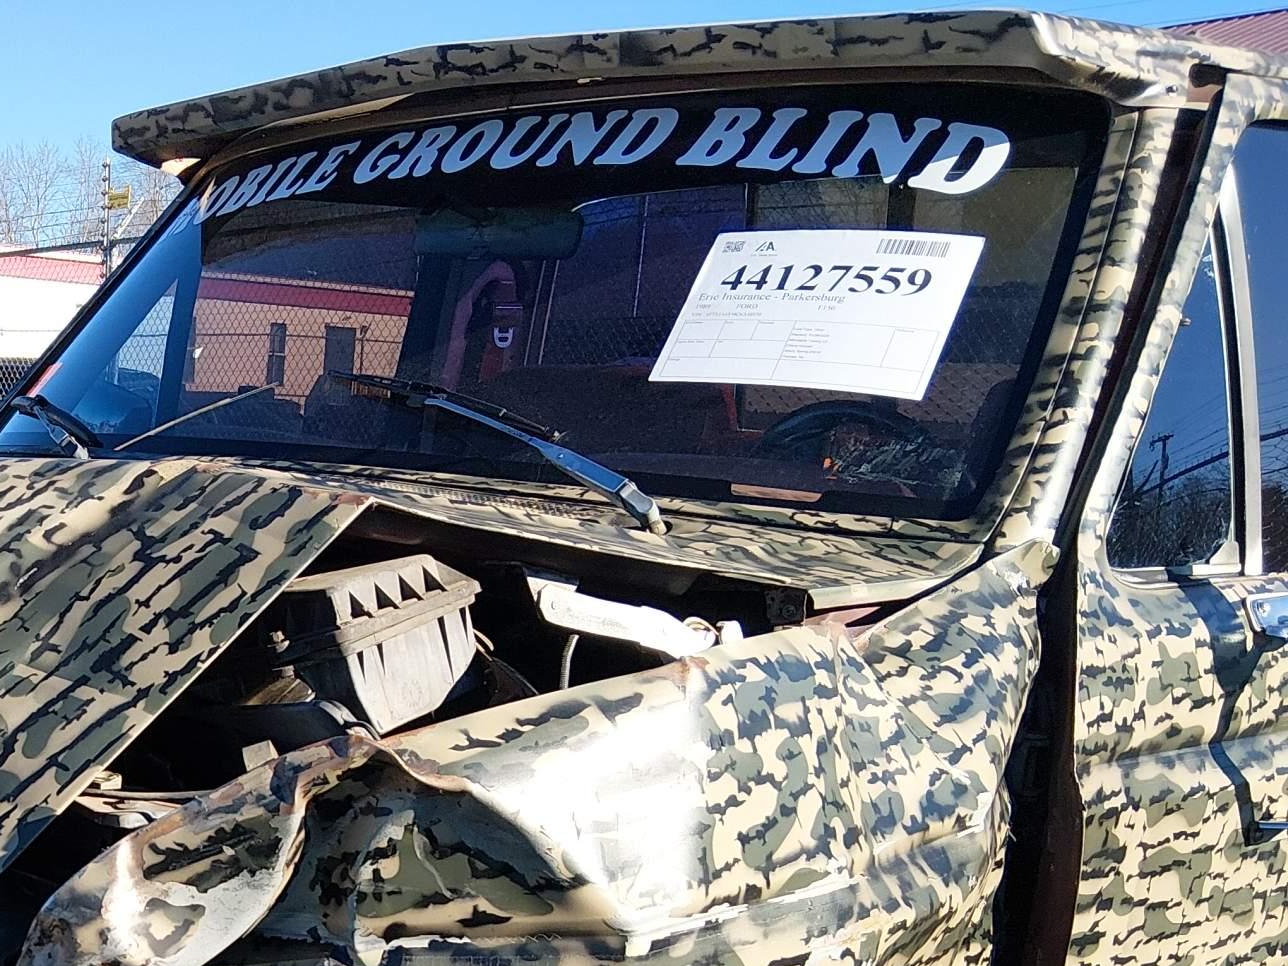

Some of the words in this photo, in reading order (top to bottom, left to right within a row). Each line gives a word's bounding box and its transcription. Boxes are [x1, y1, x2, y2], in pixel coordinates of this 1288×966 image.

[353, 108, 679, 184] GROUND
[675, 107, 1011, 195] BLIND
[720, 264, 933, 296] 44127559
[721, 292, 772, 302] Insurance
[781, 292, 847, 304] Parkersburg
